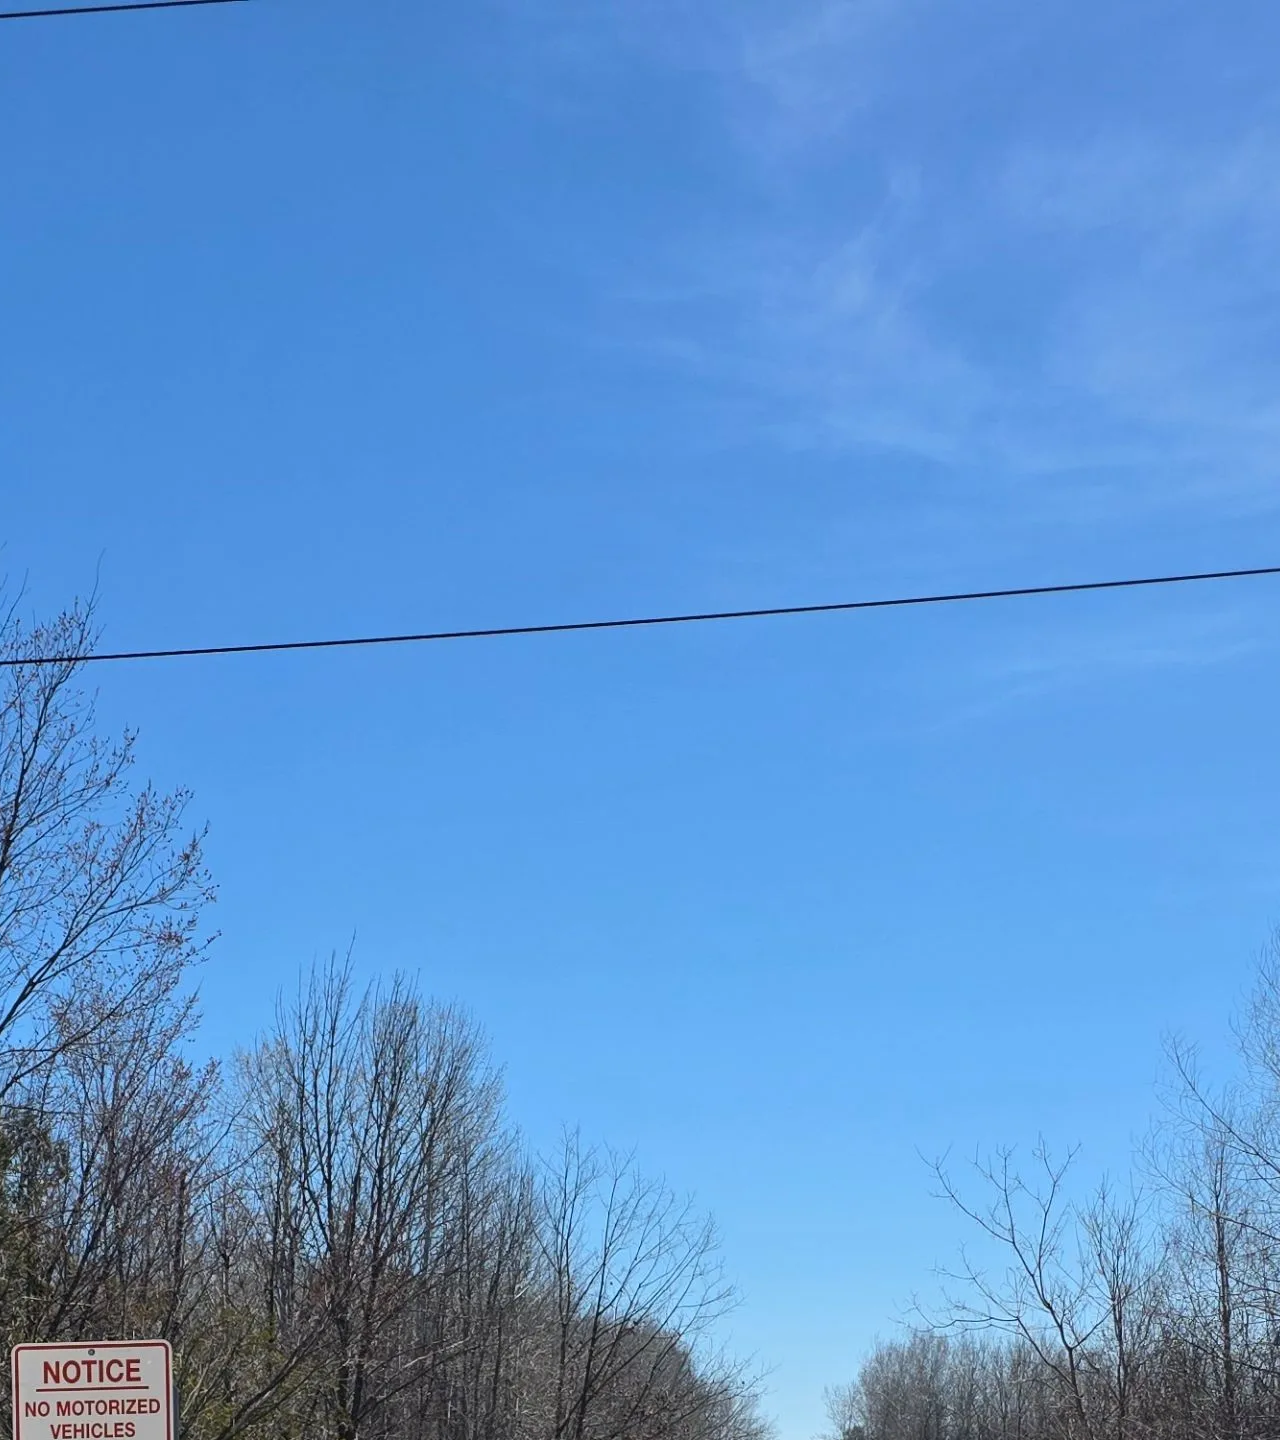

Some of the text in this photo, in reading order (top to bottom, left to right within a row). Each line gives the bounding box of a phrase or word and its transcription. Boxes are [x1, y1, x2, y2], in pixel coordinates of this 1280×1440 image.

[43, 1359, 141, 1384] NOTICE
[25, 1398, 161, 1417] NO MOTORIZED
[50, 1422, 136, 1439] VEHICLES
